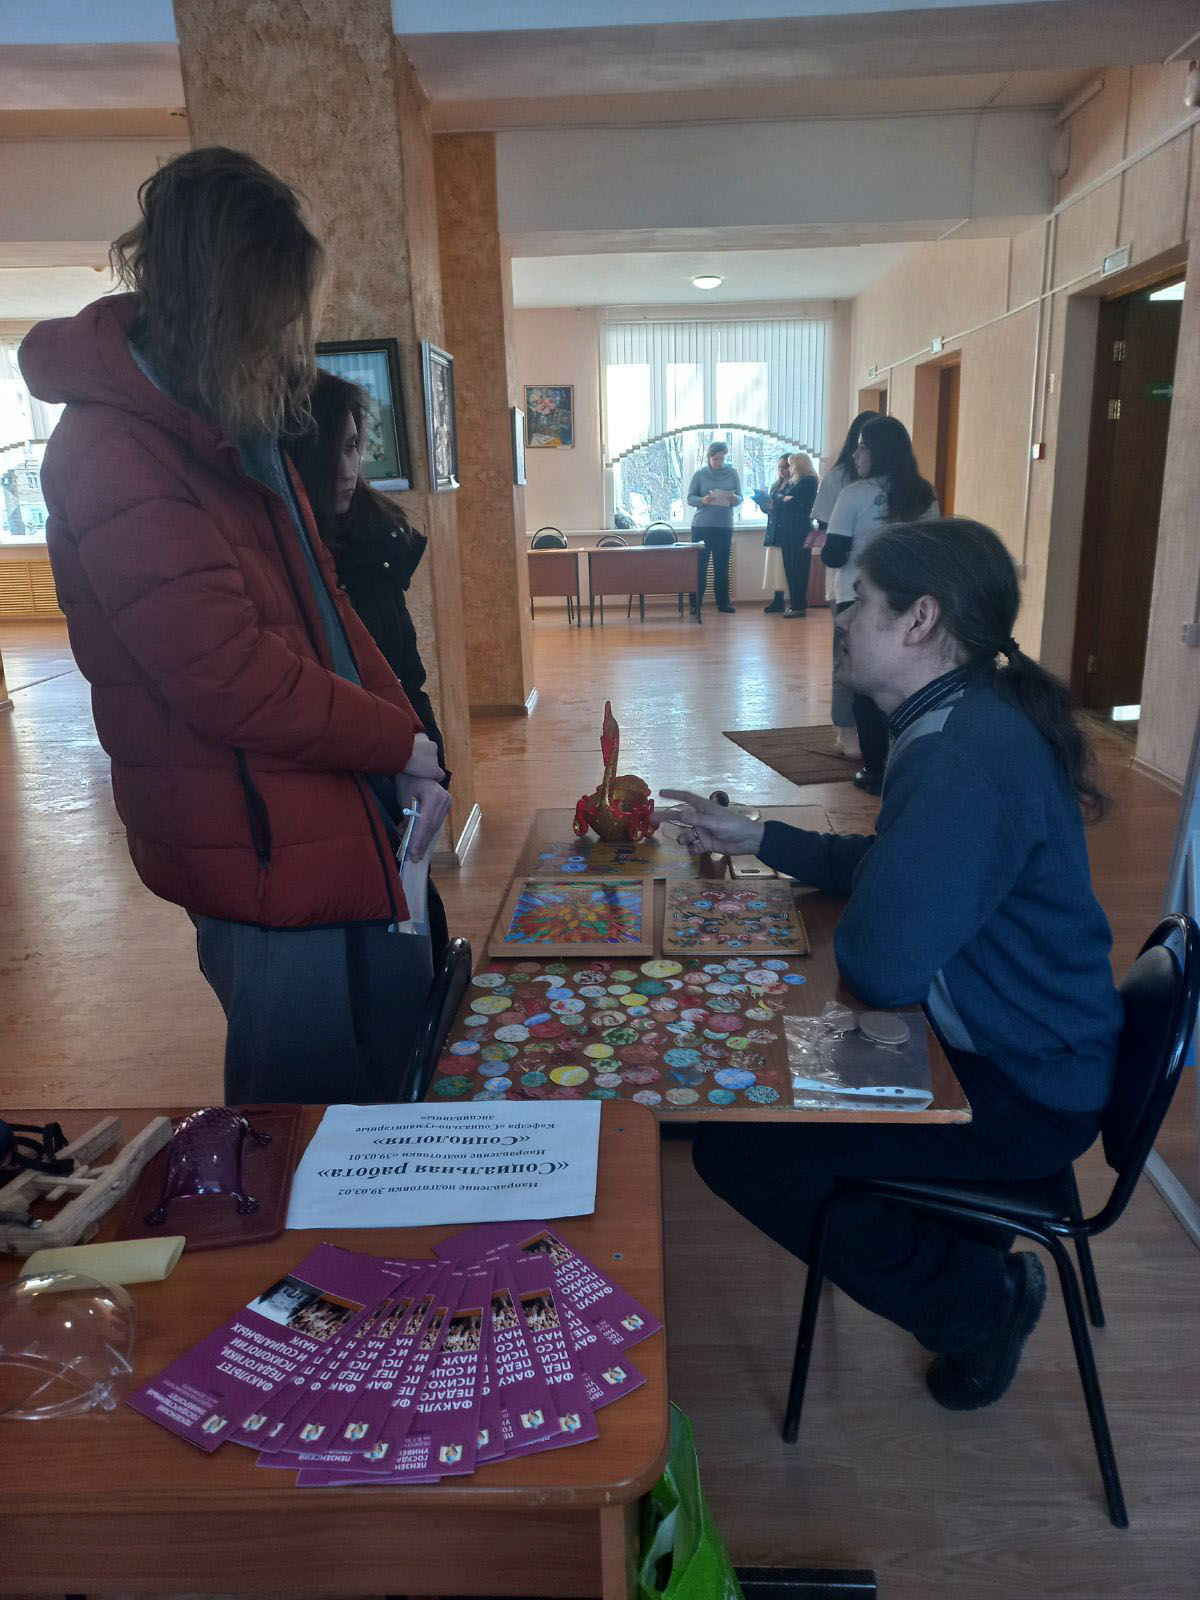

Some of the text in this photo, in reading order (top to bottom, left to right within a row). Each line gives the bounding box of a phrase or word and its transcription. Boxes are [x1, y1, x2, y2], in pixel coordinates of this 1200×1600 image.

[508, 1122, 556, 1130] Кафедра
[372, 1135, 530, 1146] «Социология»
[401, 1152, 468, 1161] подготовки
[470, 1149, 546, 1160] Направление
[317, 1160, 569, 1180] «Социальная работа»
[338, 1182, 538, 1196] Направление подготовки 39.03.02
[554, 1258, 583, 1277] НАУК
[580, 1264, 590, 1273] И
[568, 1278, 606, 1303] ПЕДАГ
[230, 1322, 308, 1362] И СОЦИАЛЬНЫХ
[288, 1336, 319, 1353] НАУК
[516, 1338, 526, 1348] И
[556, 1340, 566, 1348] И
[230, 1338, 297, 1372] ПСИХОЛОГИИ
[442, 1354, 478, 1366] НАУК
[220, 1346, 286, 1382] ПЕДАГОГИКИ,
[467, 1365, 477, 1374] И
[216, 1361, 273, 1392] ФАКУЛЬТЕТ
[424, 1376, 476, 1390] ПСИХО
